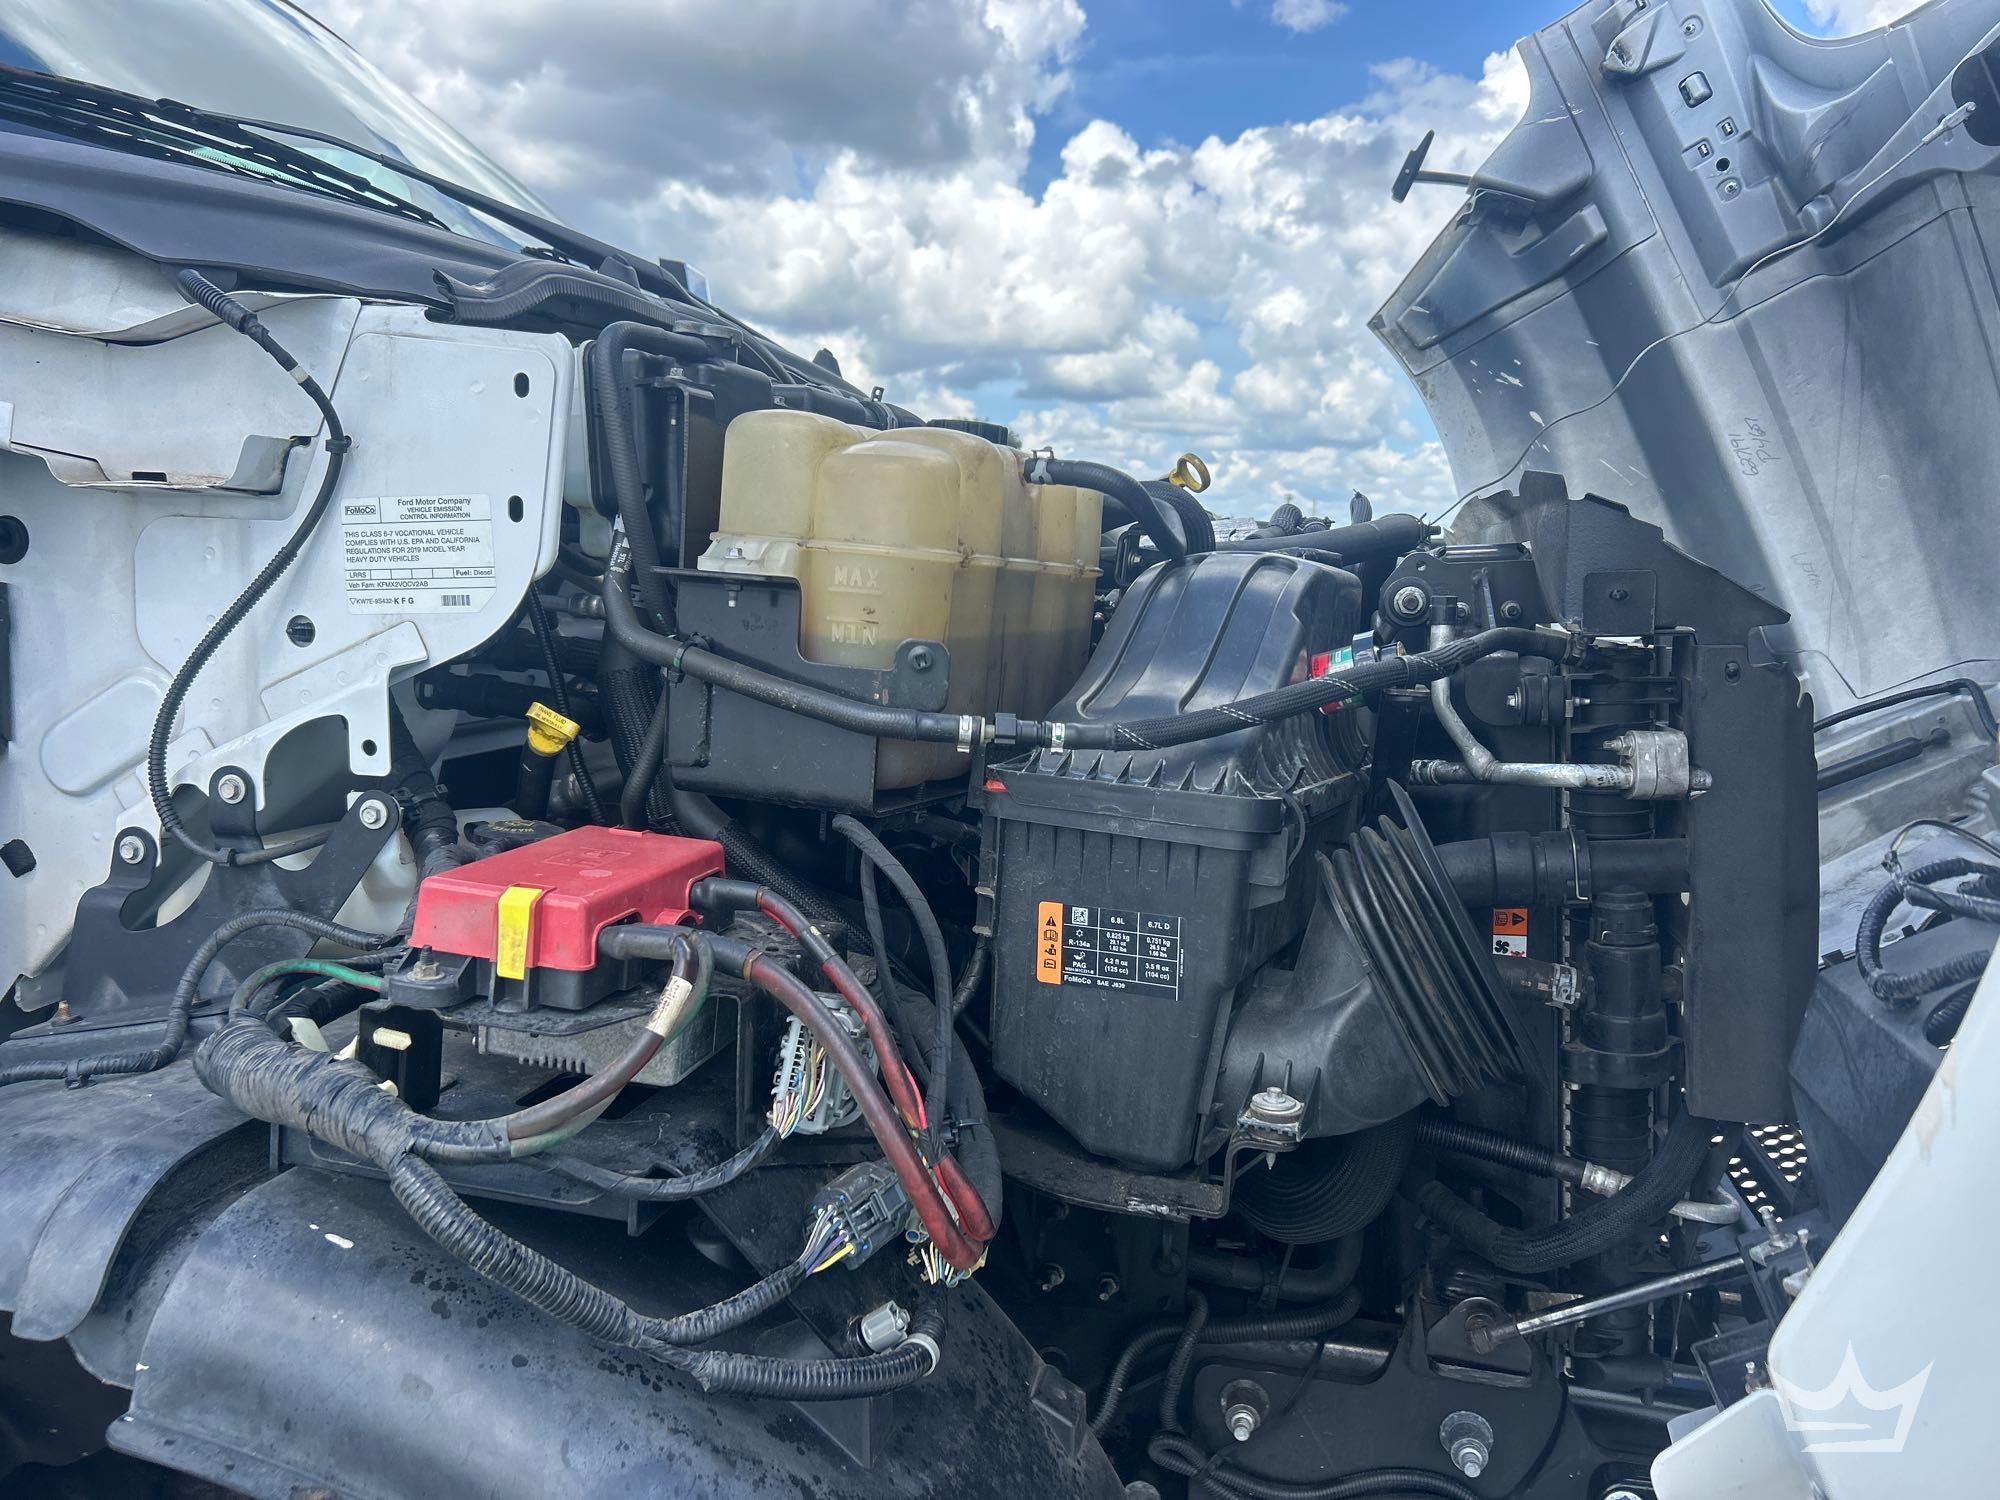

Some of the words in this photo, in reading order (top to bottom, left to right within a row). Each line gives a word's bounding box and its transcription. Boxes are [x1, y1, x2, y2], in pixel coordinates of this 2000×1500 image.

[438, 497, 471, 505] Company
[345, 506, 376, 515] FoMoCo
[834, 564, 880, 588] MAX
[831, 622, 880, 647] MIN
[1110, 917, 1125, 925] 6.8L
[1147, 921, 1163, 929] 6.7L
[1122, 934, 1130, 942] kg
[1068, 939, 1091, 947] R-134a
[1163, 939, 1170, 947] kg
[1072, 961, 1087, 969] PAG
[1064, 975, 1091, 985] FoMoCo
[1096, 979, 1109, 987] SAE
[1160, 973, 1170, 981] cc)
